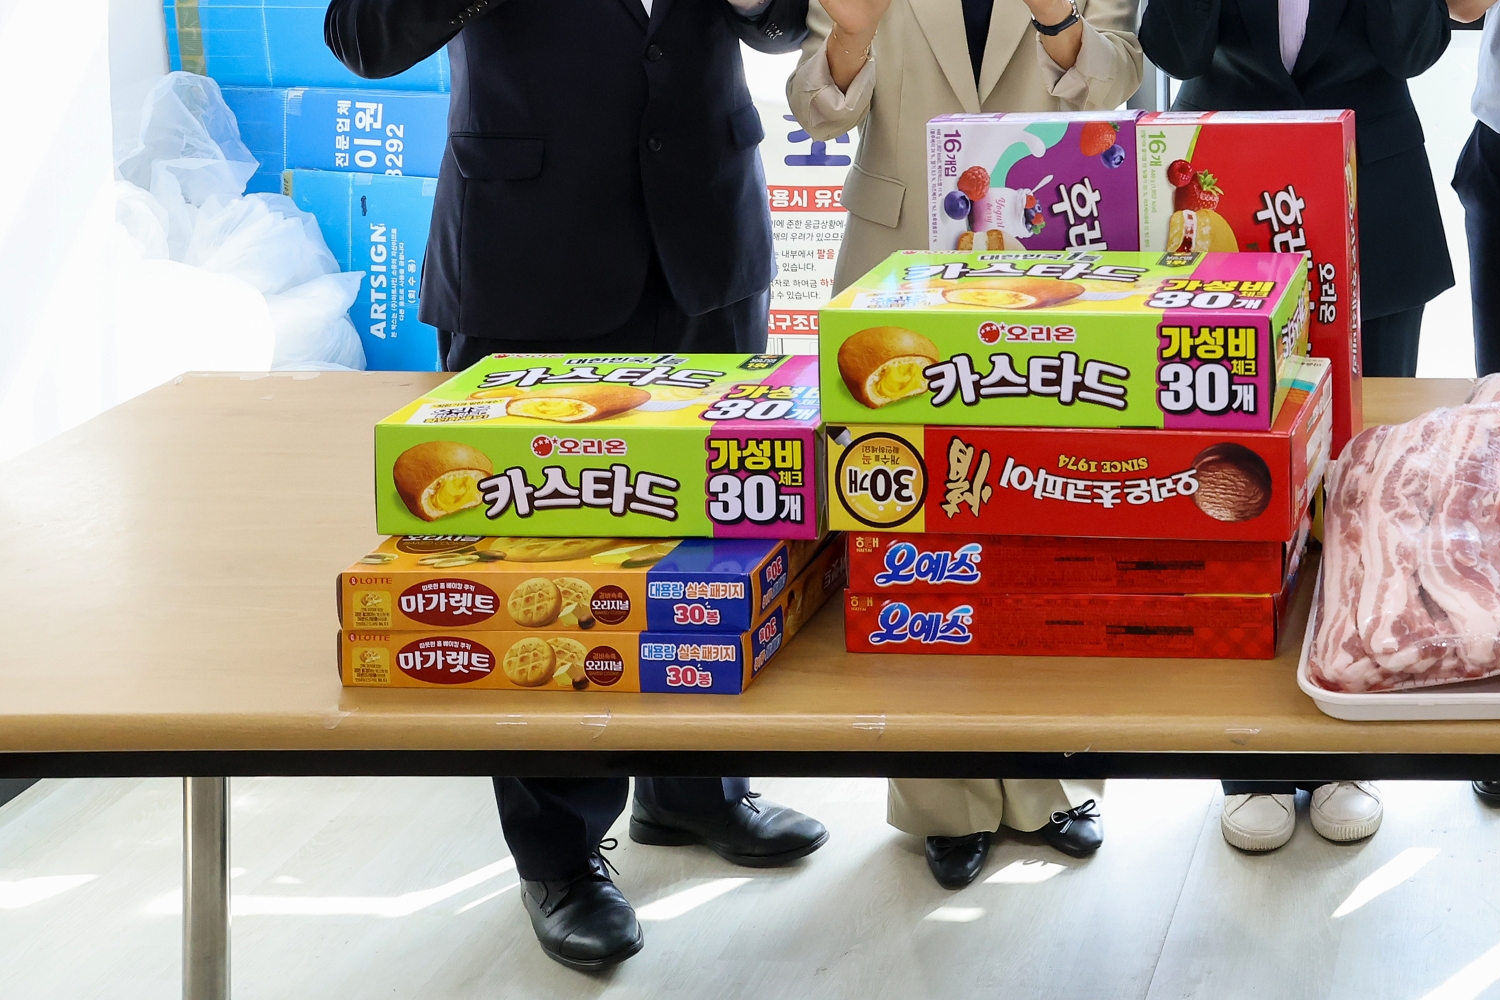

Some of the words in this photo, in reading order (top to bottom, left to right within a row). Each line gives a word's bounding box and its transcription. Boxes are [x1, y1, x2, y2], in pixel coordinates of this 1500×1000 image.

[944, 129, 962, 177] 16개입
[1148, 130, 1167, 167] 16개
[768, 189, 808, 208] 용시
[786, 220, 803, 230] 준한
[790, 233, 814, 242] 우려가
[781, 250, 814, 259] 내부에서
[816, 249, 836, 260] 팔을
[782, 263, 817, 272] 있습니다.
[904, 263, 1149, 282] 카스타드
[793, 279, 818, 289] 하여금
[1162, 280, 1276, 292] 가성비
[1318, 263, 1337, 323] 오리온
[786, 291, 821, 301] 있습니다.
[1149, 292, 1263, 309] 30개
[1006, 326, 1075, 342] 오리온
[1161, 327, 1256, 359] 가성비
[477, 366, 727, 388] 카스타드
[1231, 360, 1256, 376] 체크
[924, 352, 1129, 408] 카스타드
[1160, 362, 1255, 412] 30개
[559, 439, 626, 455] 오리온
[710, 440, 802, 470] 가성비
[1058, 454, 1098, 473] 1974
[1101, 457, 1149, 476] SINCE
[778, 471, 803, 486] 체크
[848, 467, 916, 503] 30개
[1000, 457, 1123, 509] 초코파이
[1124, 469, 1199, 505] 오리온
[479, 465, 677, 519] 카스타드
[709, 474, 802, 521] 30개
[874, 542, 981, 588] 오예스
[359, 577, 393, 585] LOTTE
[648, 582, 684, 599] 대용량
[401, 592, 495, 616] 마가렛트
[592, 599, 630, 611] 오리지널
[674, 603, 720, 625] 30봉
[869, 601, 973, 646] 오예스
[641, 643, 676, 660] 대용량
[399, 651, 491, 674] 마가렛트
[585, 660, 624, 672] 오리지널
[666, 665, 712, 687] 30봉
